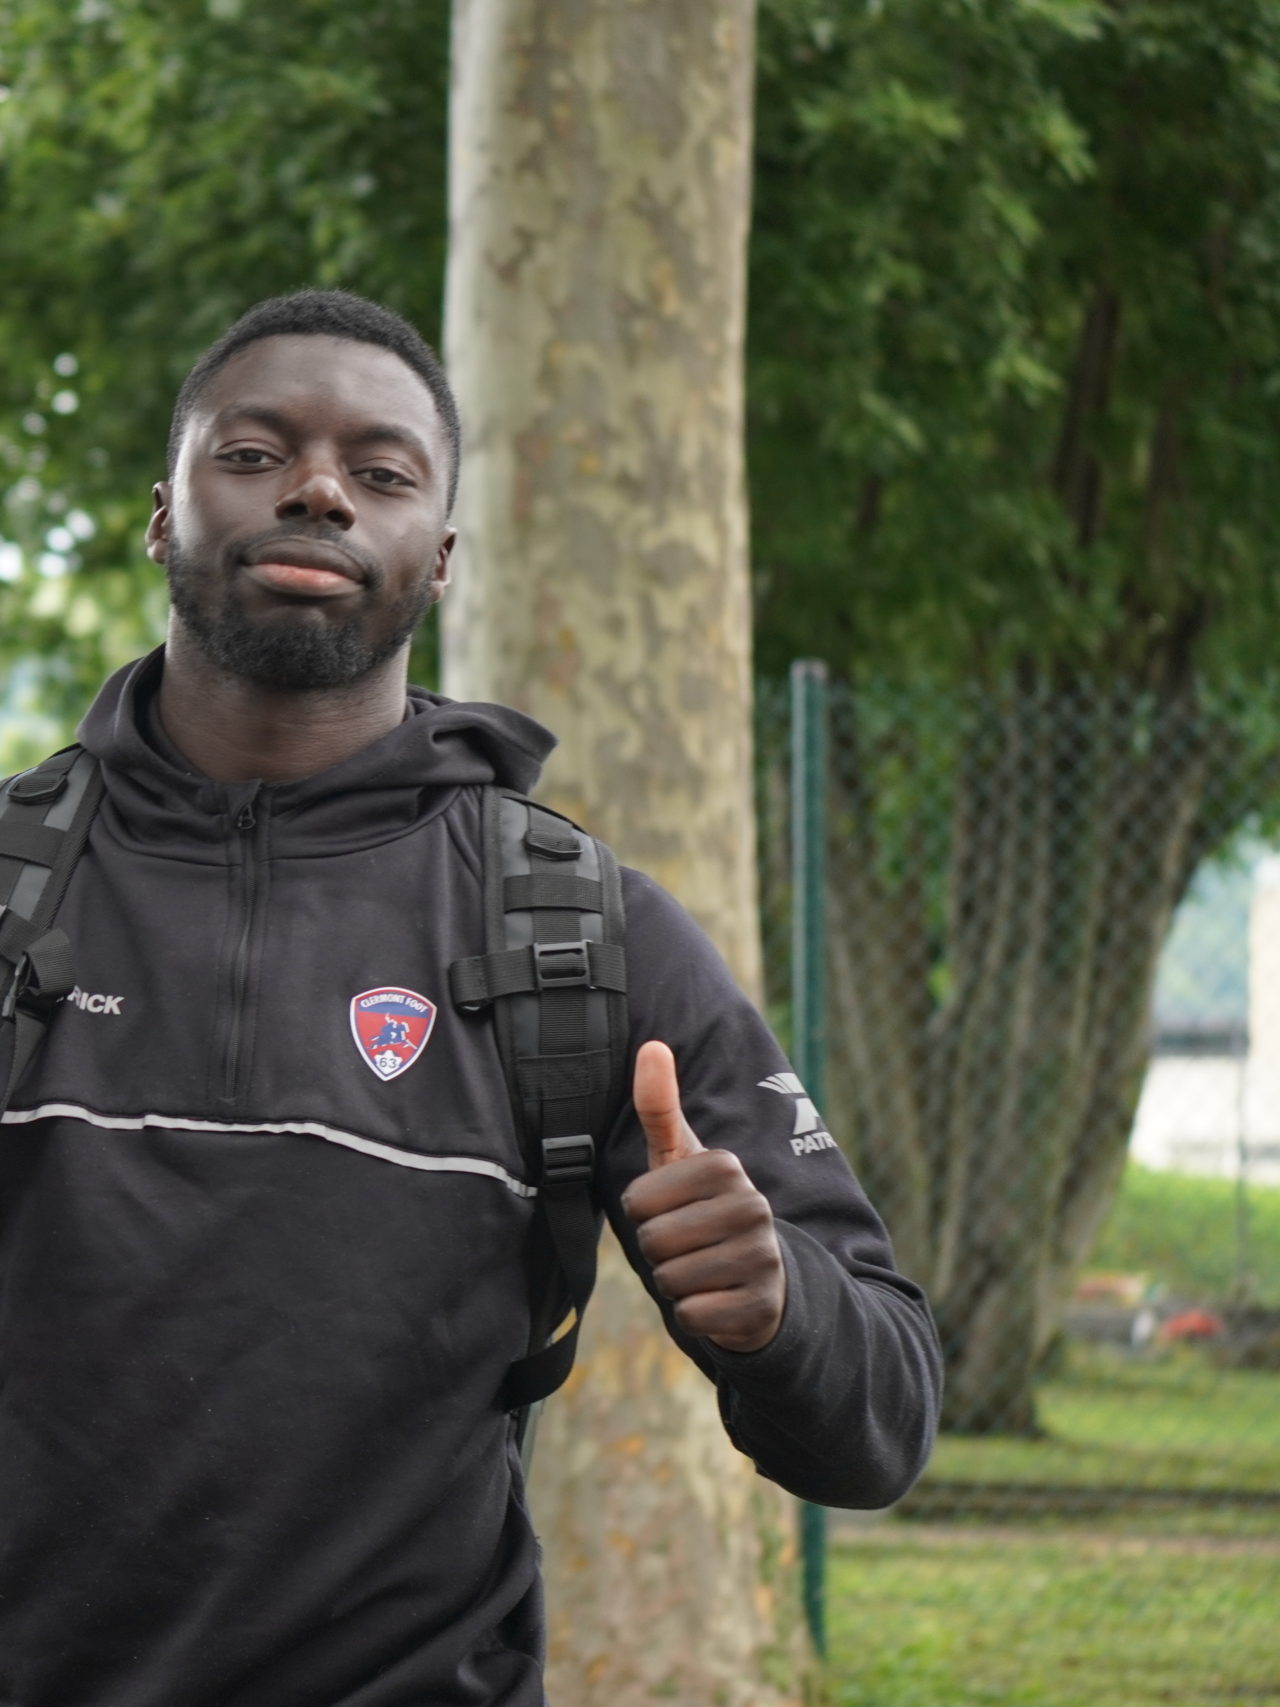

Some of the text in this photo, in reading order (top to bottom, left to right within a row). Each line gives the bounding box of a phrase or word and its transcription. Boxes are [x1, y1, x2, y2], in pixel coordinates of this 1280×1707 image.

[56, 985, 125, 1015] RICK
[405, 997, 428, 1013] FOOT
[379, 1057, 397, 1069] 63
